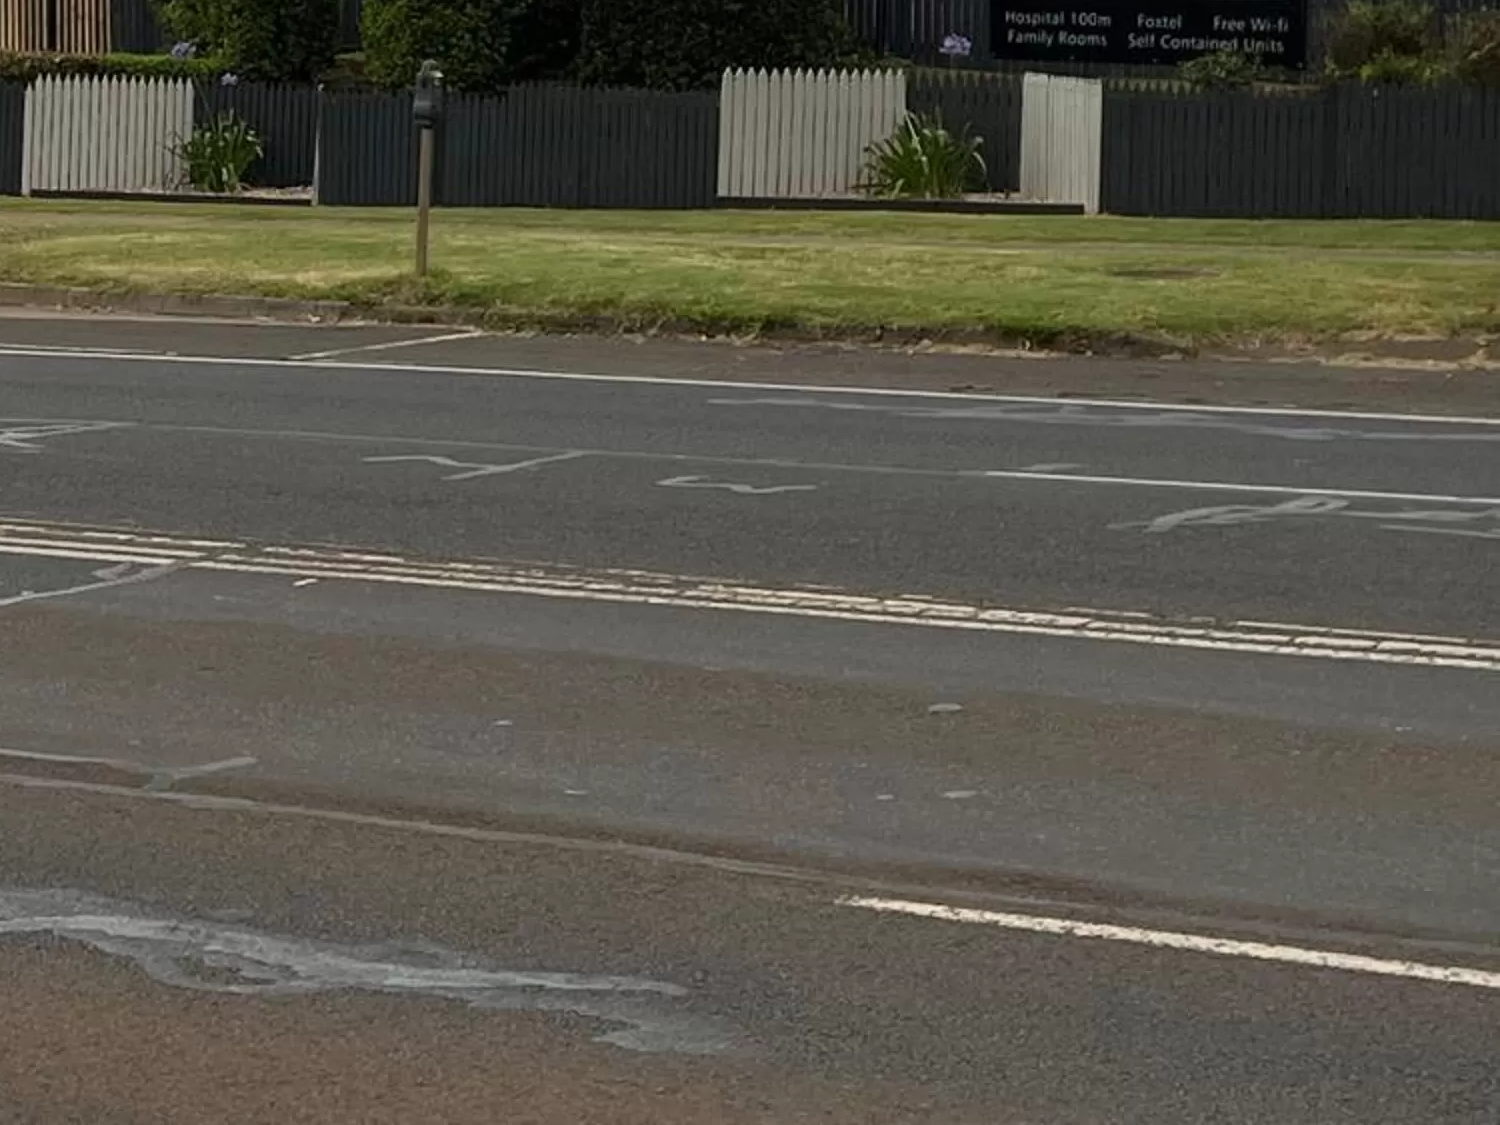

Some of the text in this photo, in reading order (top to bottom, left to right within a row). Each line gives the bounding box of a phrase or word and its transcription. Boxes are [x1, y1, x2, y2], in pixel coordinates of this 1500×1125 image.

[1005, 10, 1065, 27] Hospital
[1071, 11, 1112, 27] 100m
[1213, 15, 1246, 32] Free
[1007, 28, 1285, 53] Family Rooms Self Contained Units
